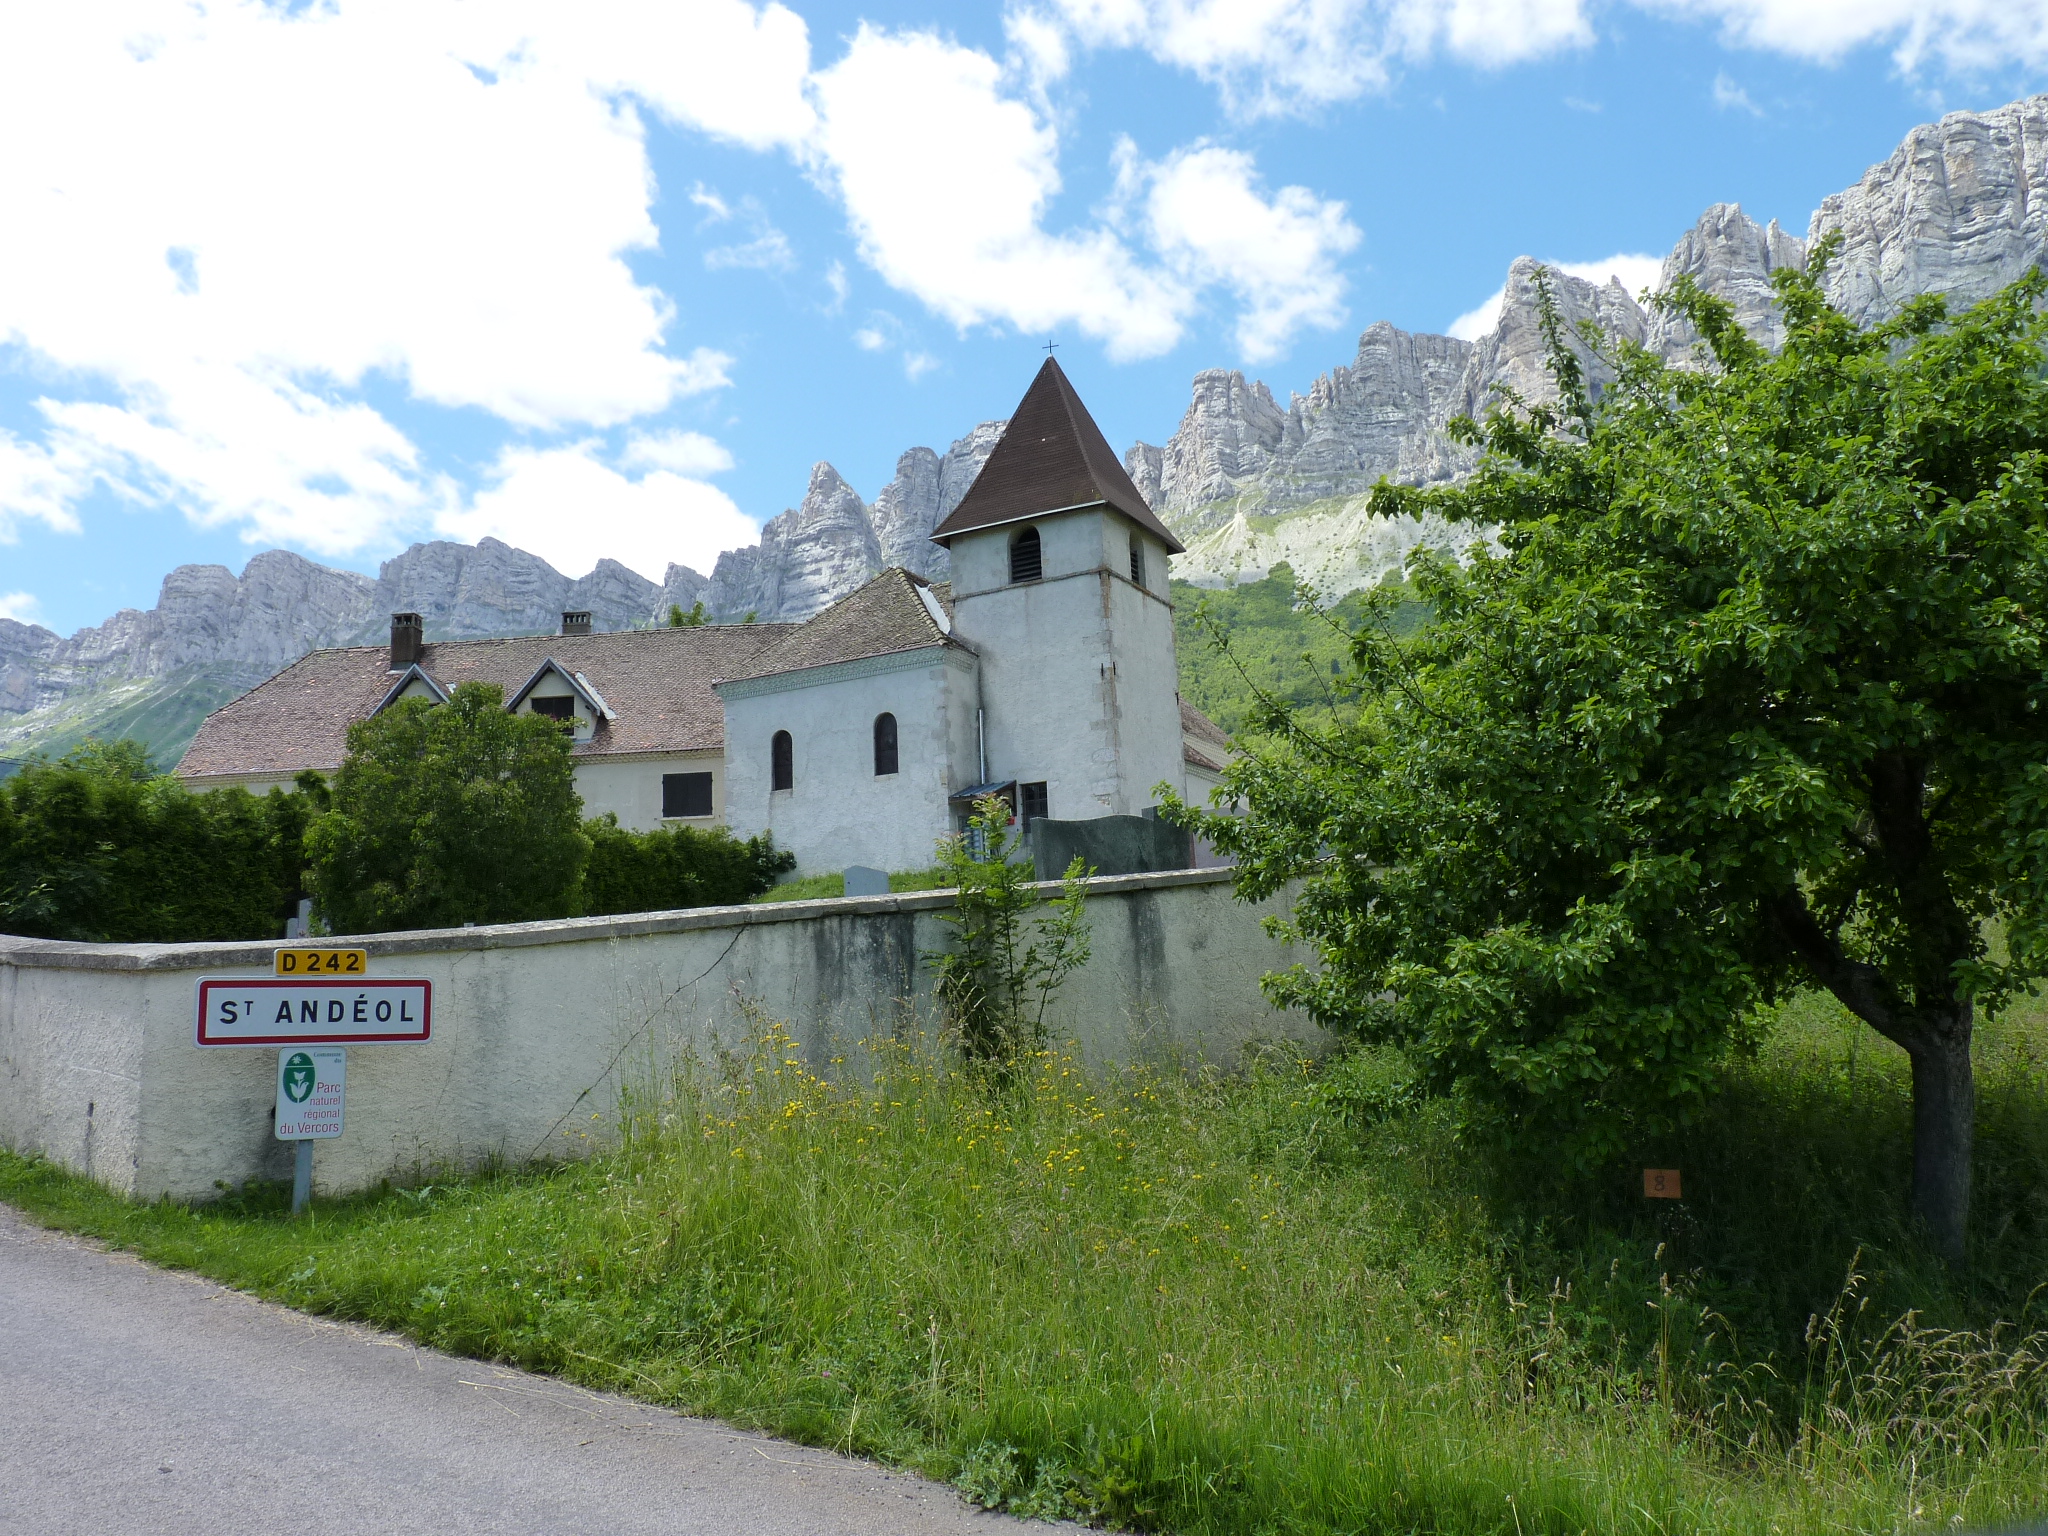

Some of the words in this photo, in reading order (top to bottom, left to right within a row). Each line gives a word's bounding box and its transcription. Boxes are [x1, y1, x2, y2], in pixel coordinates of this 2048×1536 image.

[283, 953, 297, 972] D
[307, 953, 360, 972] 242
[275, 994, 414, 1023] ANDÉOL
[316, 1082, 341, 1094] Parc
[309, 1095, 341, 1106] naturel
[303, 1108, 340, 1121] régional
[280, 1123, 294, 1134] du
[297, 1122, 339, 1134] Vercors
